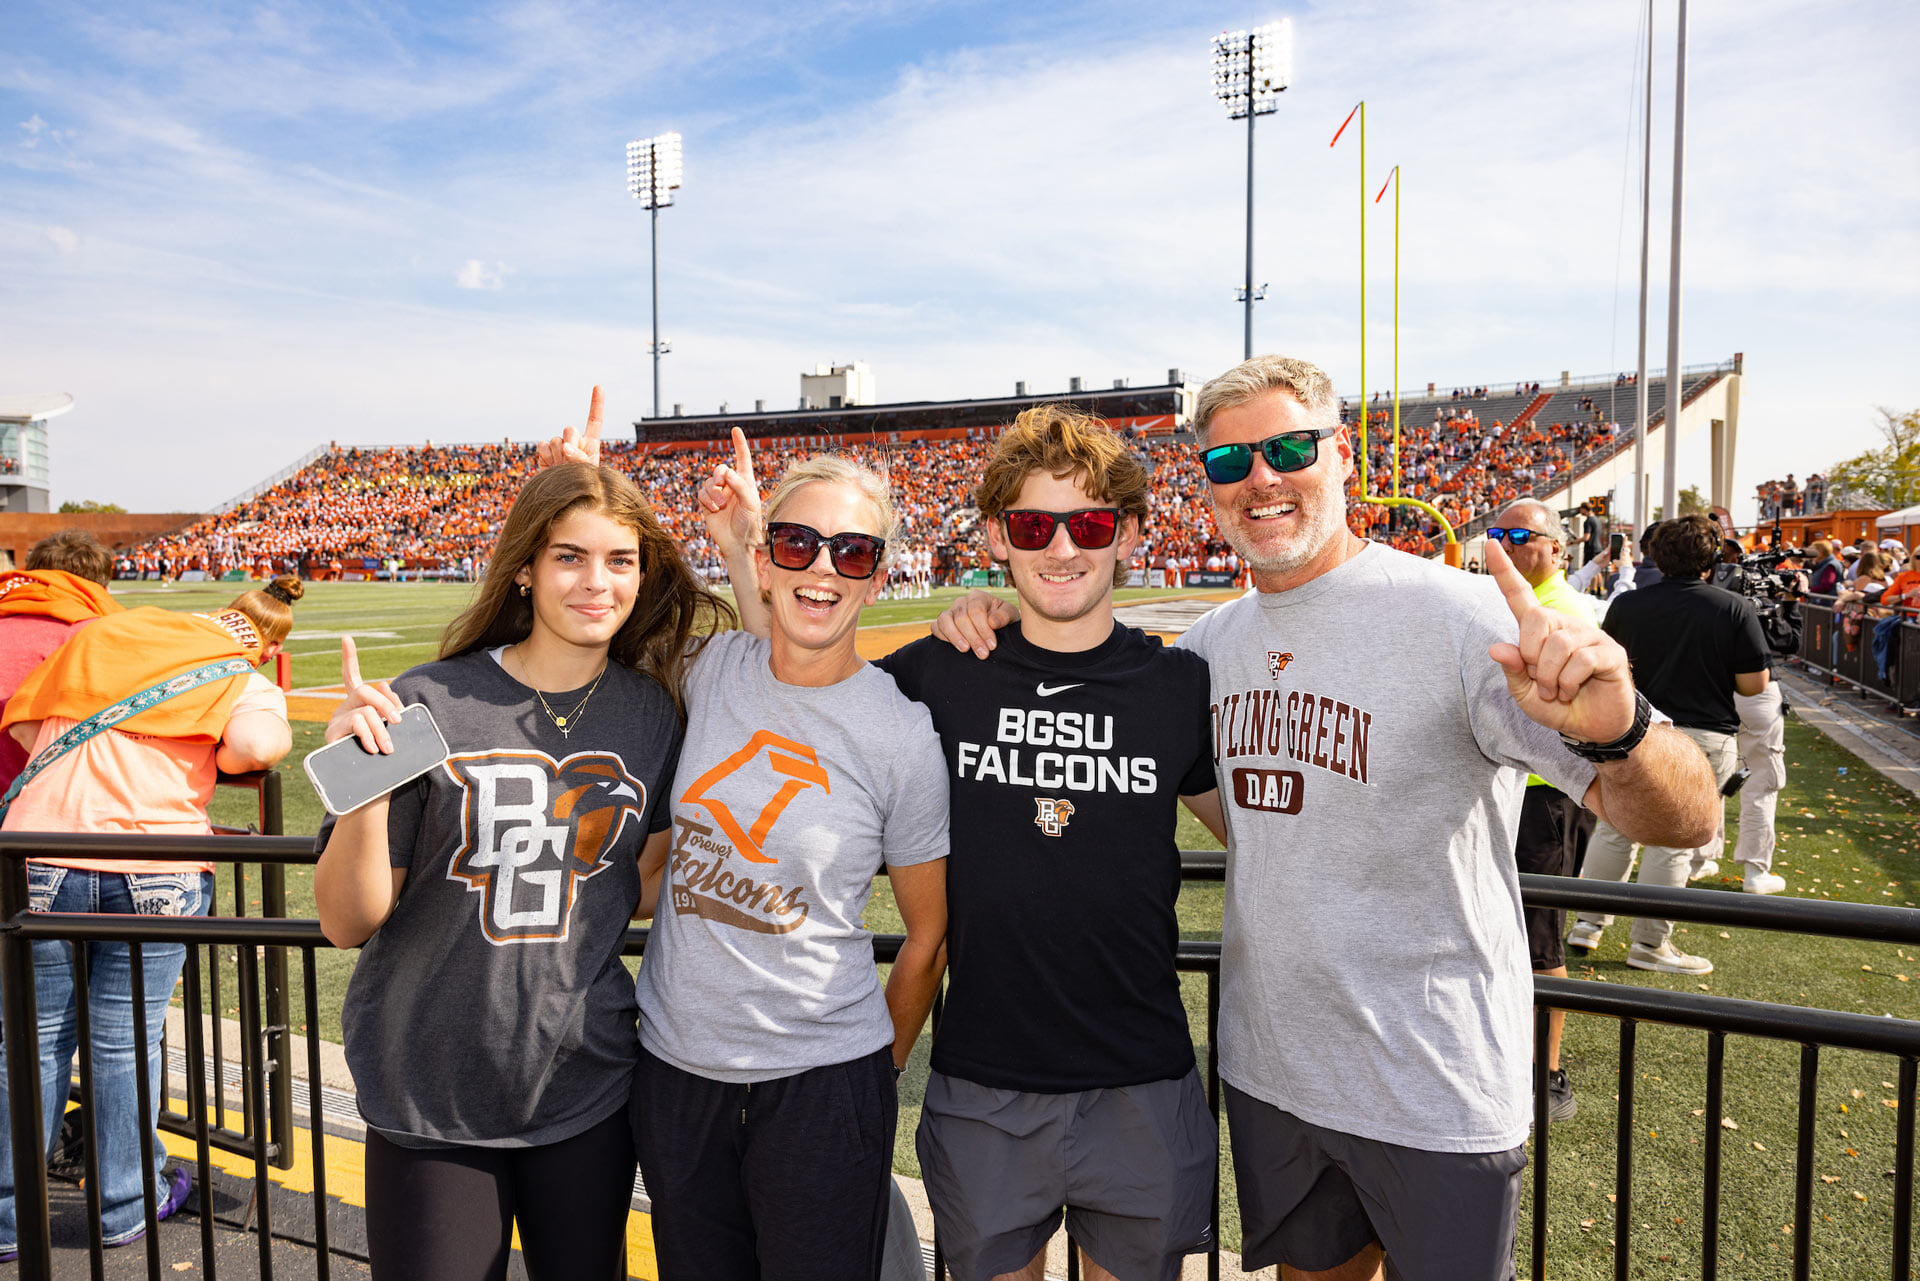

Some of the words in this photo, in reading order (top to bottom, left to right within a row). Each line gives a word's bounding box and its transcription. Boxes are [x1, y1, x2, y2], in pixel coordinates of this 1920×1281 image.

[219, 611, 259, 649] GREEN
[997, 707, 1113, 750] BGSU
[1287, 690, 1372, 786] GREEN
[958, 741, 1157, 794] FALCONS
[1245, 773, 1293, 809] DAD
[672, 830, 809, 916] Falcons
